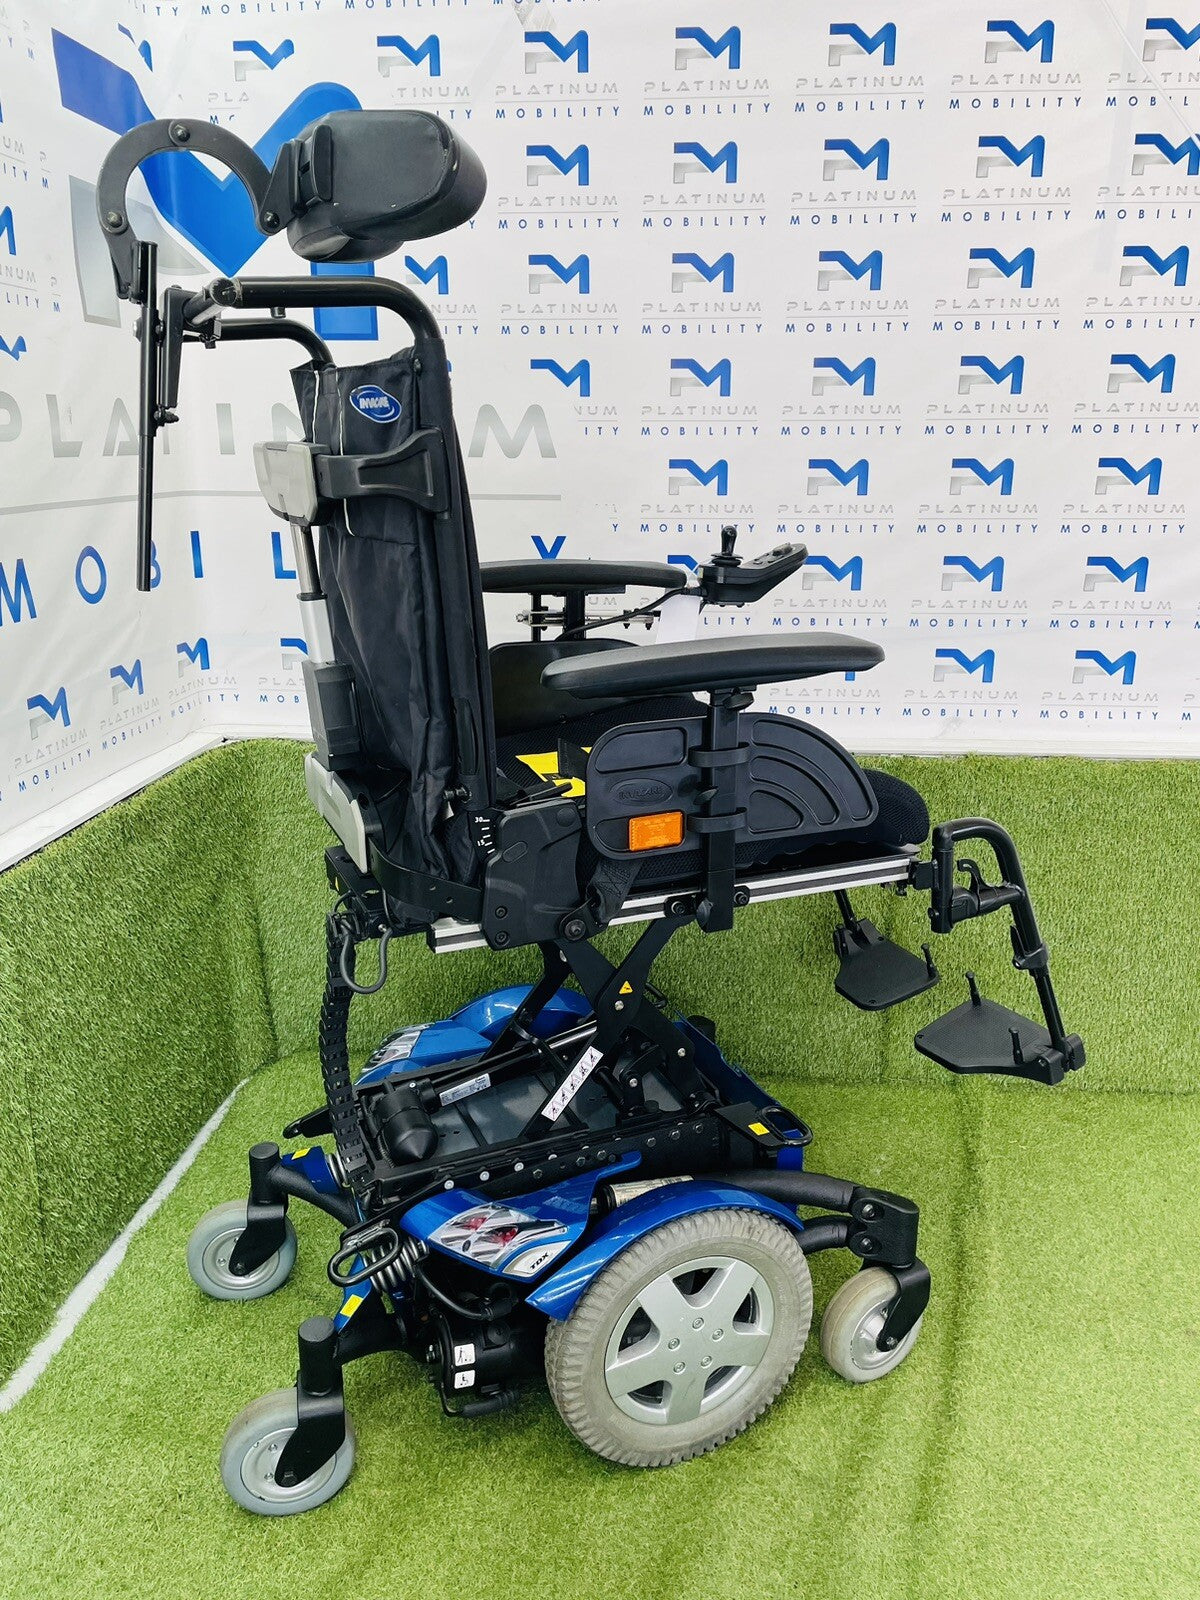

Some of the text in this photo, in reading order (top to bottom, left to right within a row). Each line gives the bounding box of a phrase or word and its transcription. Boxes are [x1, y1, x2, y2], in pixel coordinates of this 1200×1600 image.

[202, 1, 320, 14] MOBILITY
[796, 76, 924, 89] PLATINUM
[951, 73, 1081, 85] PLATINUM
[496, 83, 618, 95] PLATINUM
[644, 79, 769, 92] PLATINUM
[393, 86, 470, 97] TINUM
[795, 100, 924, 112] MOBILITY
[949, 97, 1081, 109] MOBILITY
[496, 107, 619, 118] MOBILITY
[644, 103, 770, 115] MOBILITY
[791, 190, 916, 202] PLATINUM
[943, 187, 1071, 199] PLATINUM
[498, 196, 617, 206] PLATINUM
[643, 193, 765, 205] PLATINUM
[643, 216, 766, 227] MOBILITY
[790, 213, 916, 224] MOBILITY
[941, 211, 1070, 222] MOBILITY
[499, 218, 618, 229] MOBILITY
[642, 302, 761, 312] PLATINUM
[787, 300, 908, 311] PLATINUM
[935, 298, 1059, 309] PLATINUM
[1086, 297, 1200, 307] PLATINU
[501, 303, 617, 313] PLATINUM
[502, 325, 618, 334] MOBILITY
[642, 324, 762, 334] MOBILITY
[786, 322, 908, 332] MOBILITY
[933, 320, 1059, 330] MOBILITY
[642, 406, 757, 415] PLATINUM
[782, 405, 901, 415] PLATINUM
[927, 403, 1048, 414] PLATINUM
[1074, 402, 1199, 412] PLATINUM
[641, 427, 758, 435] MOBILITY
[781, 426, 901, 435] MOBILITY
[925, 425, 1048, 434] MOBILITY
[1072, 424, 1198, 433] MOBILITY
[641, 504, 753, 513] PLATINUM
[778, 504, 893, 513] PLATINUM
[919, 504, 1037, 513] PLATINUM
[1063, 504, 1185, 513] PLATINUM
[777, 524, 894, 533] MOBILITY
[917, 524, 1037, 533] MOBILITY
[1061, 524, 1184, 533] MOBILITY
[774, 599, 886, 607] PLATINUM
[912, 600, 1027, 608] PLATINUM
[1052, 600, 1171, 610] PLATINUM
[773, 618, 887, 626] MOBILITY
[910, 619, 1027, 627] MOBILITY
[1050, 620, 1171, 628] MOBILITY
[770, 688, 880, 697] PLATINUM
[905, 690, 1017, 699] PLATINUM
[1042, 692, 1158, 701] PLATINUM
[100, 697, 160, 730] PLATINUM
[768, 706, 881, 715] MOBILITY
[903, 708, 1017, 717] MOBILITY
[1040, 710, 1158, 719] MOBILITY
[102, 716, 163, 750] MOBILITY
[14, 728, 88, 769] PLATINUM
[18, 749, 91, 792] MOBILITY
[530, 1252, 549, 1269] TDX
